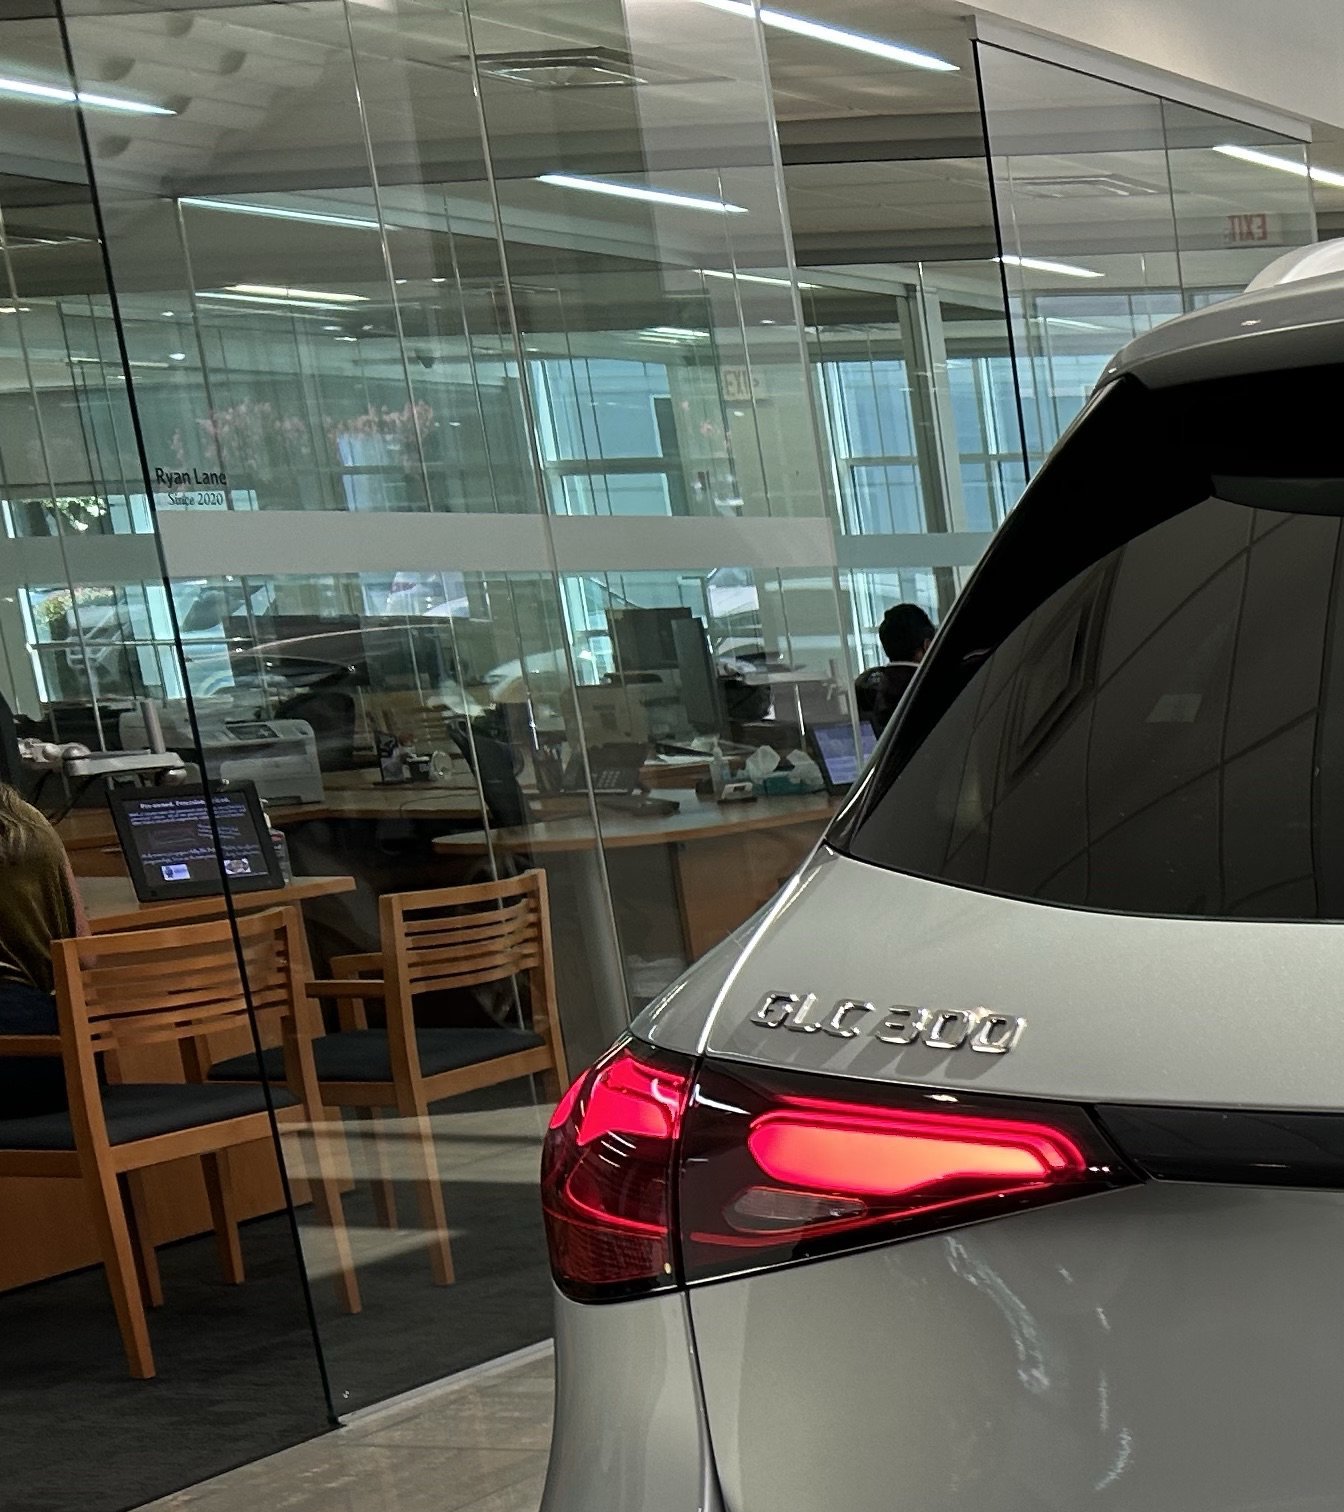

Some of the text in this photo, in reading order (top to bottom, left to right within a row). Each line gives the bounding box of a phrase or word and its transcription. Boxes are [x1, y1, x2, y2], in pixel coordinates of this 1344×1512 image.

[724, 370, 753, 397] EXI
[155, 467, 227, 488] Ryan Lane
[168, 491, 224, 506] Since 2020
[750, 990, 1027, 1053] GLC 300
